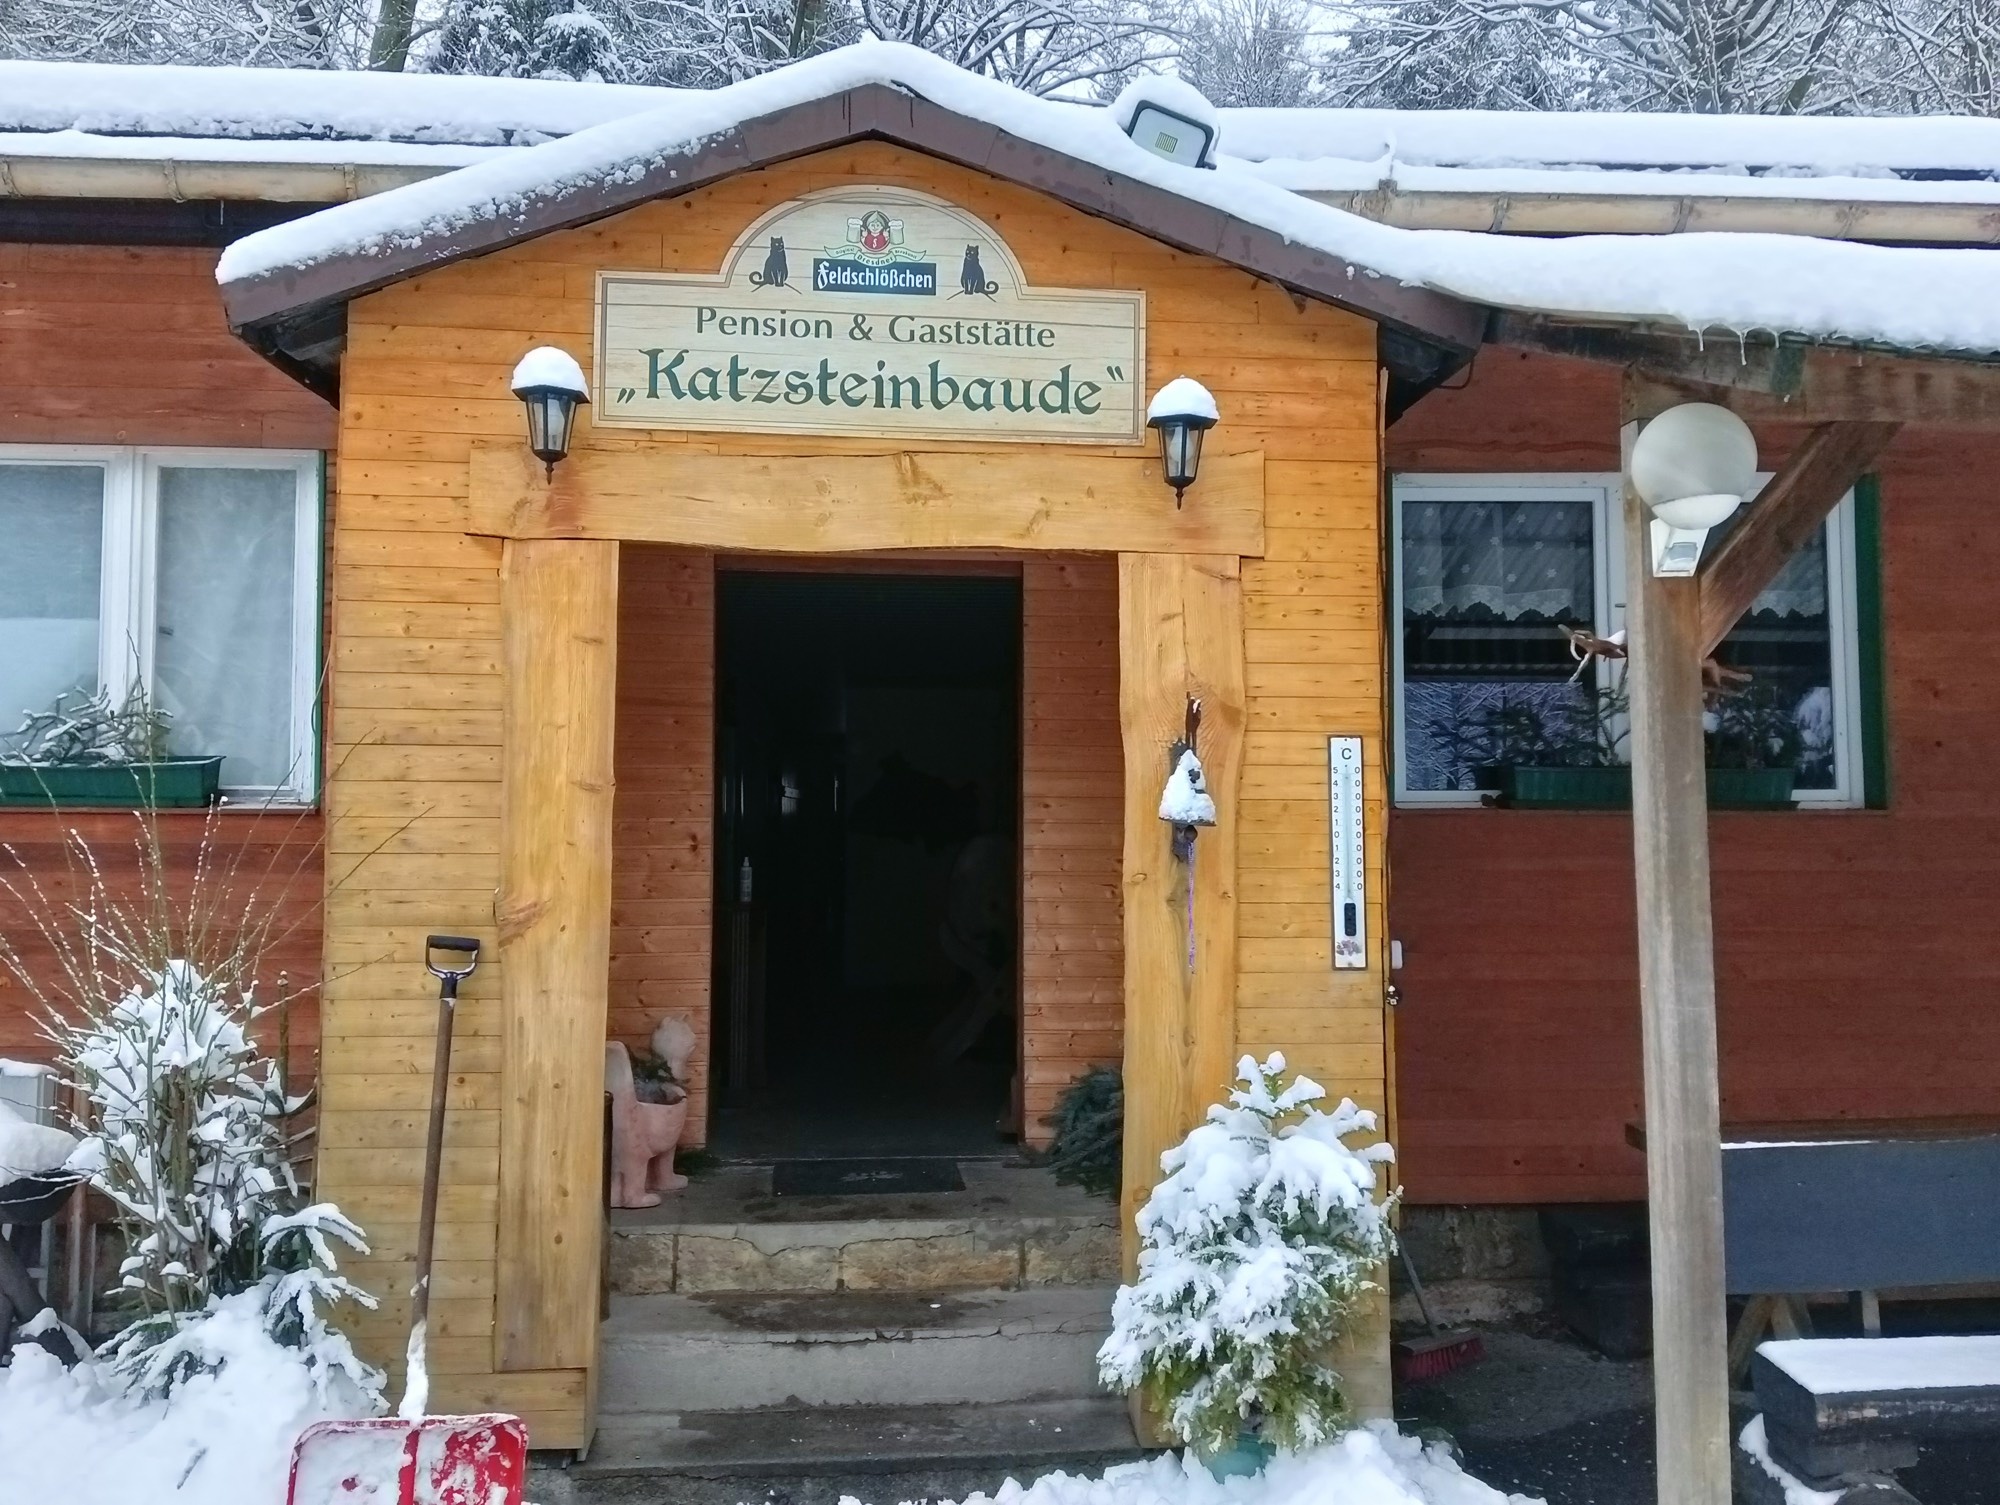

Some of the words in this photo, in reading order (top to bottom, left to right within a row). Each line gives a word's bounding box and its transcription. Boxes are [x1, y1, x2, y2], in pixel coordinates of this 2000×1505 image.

[817, 260, 933, 290] Feldschlößchen
[856, 254, 894, 266] Dresdner
[697, 306, 833, 339] Pension
[848, 313, 873, 342] &
[888, 315, 1056, 348] Gaststätte
